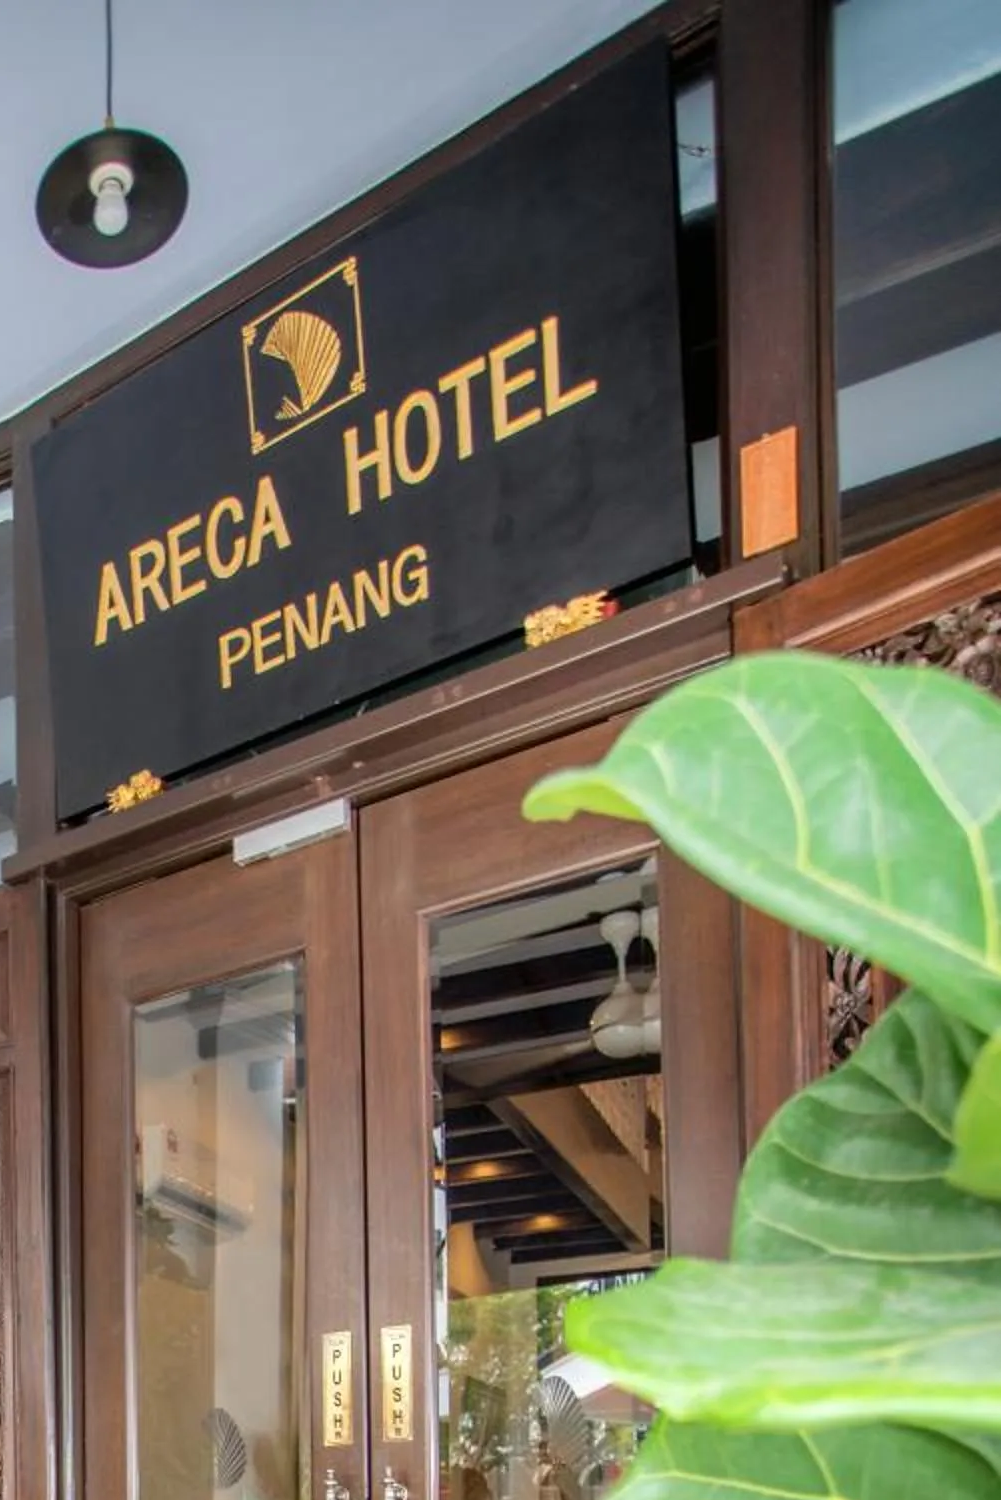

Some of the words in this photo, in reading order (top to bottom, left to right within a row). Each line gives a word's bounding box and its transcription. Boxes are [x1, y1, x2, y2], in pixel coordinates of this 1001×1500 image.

[94, 475, 292, 646] ARECA
[343, 316, 598, 514] HOTEL
[219, 544, 430, 689] PENANG
[331, 1348, 344, 1430] PUSH
[391, 1342, 404, 1425] PUSH
